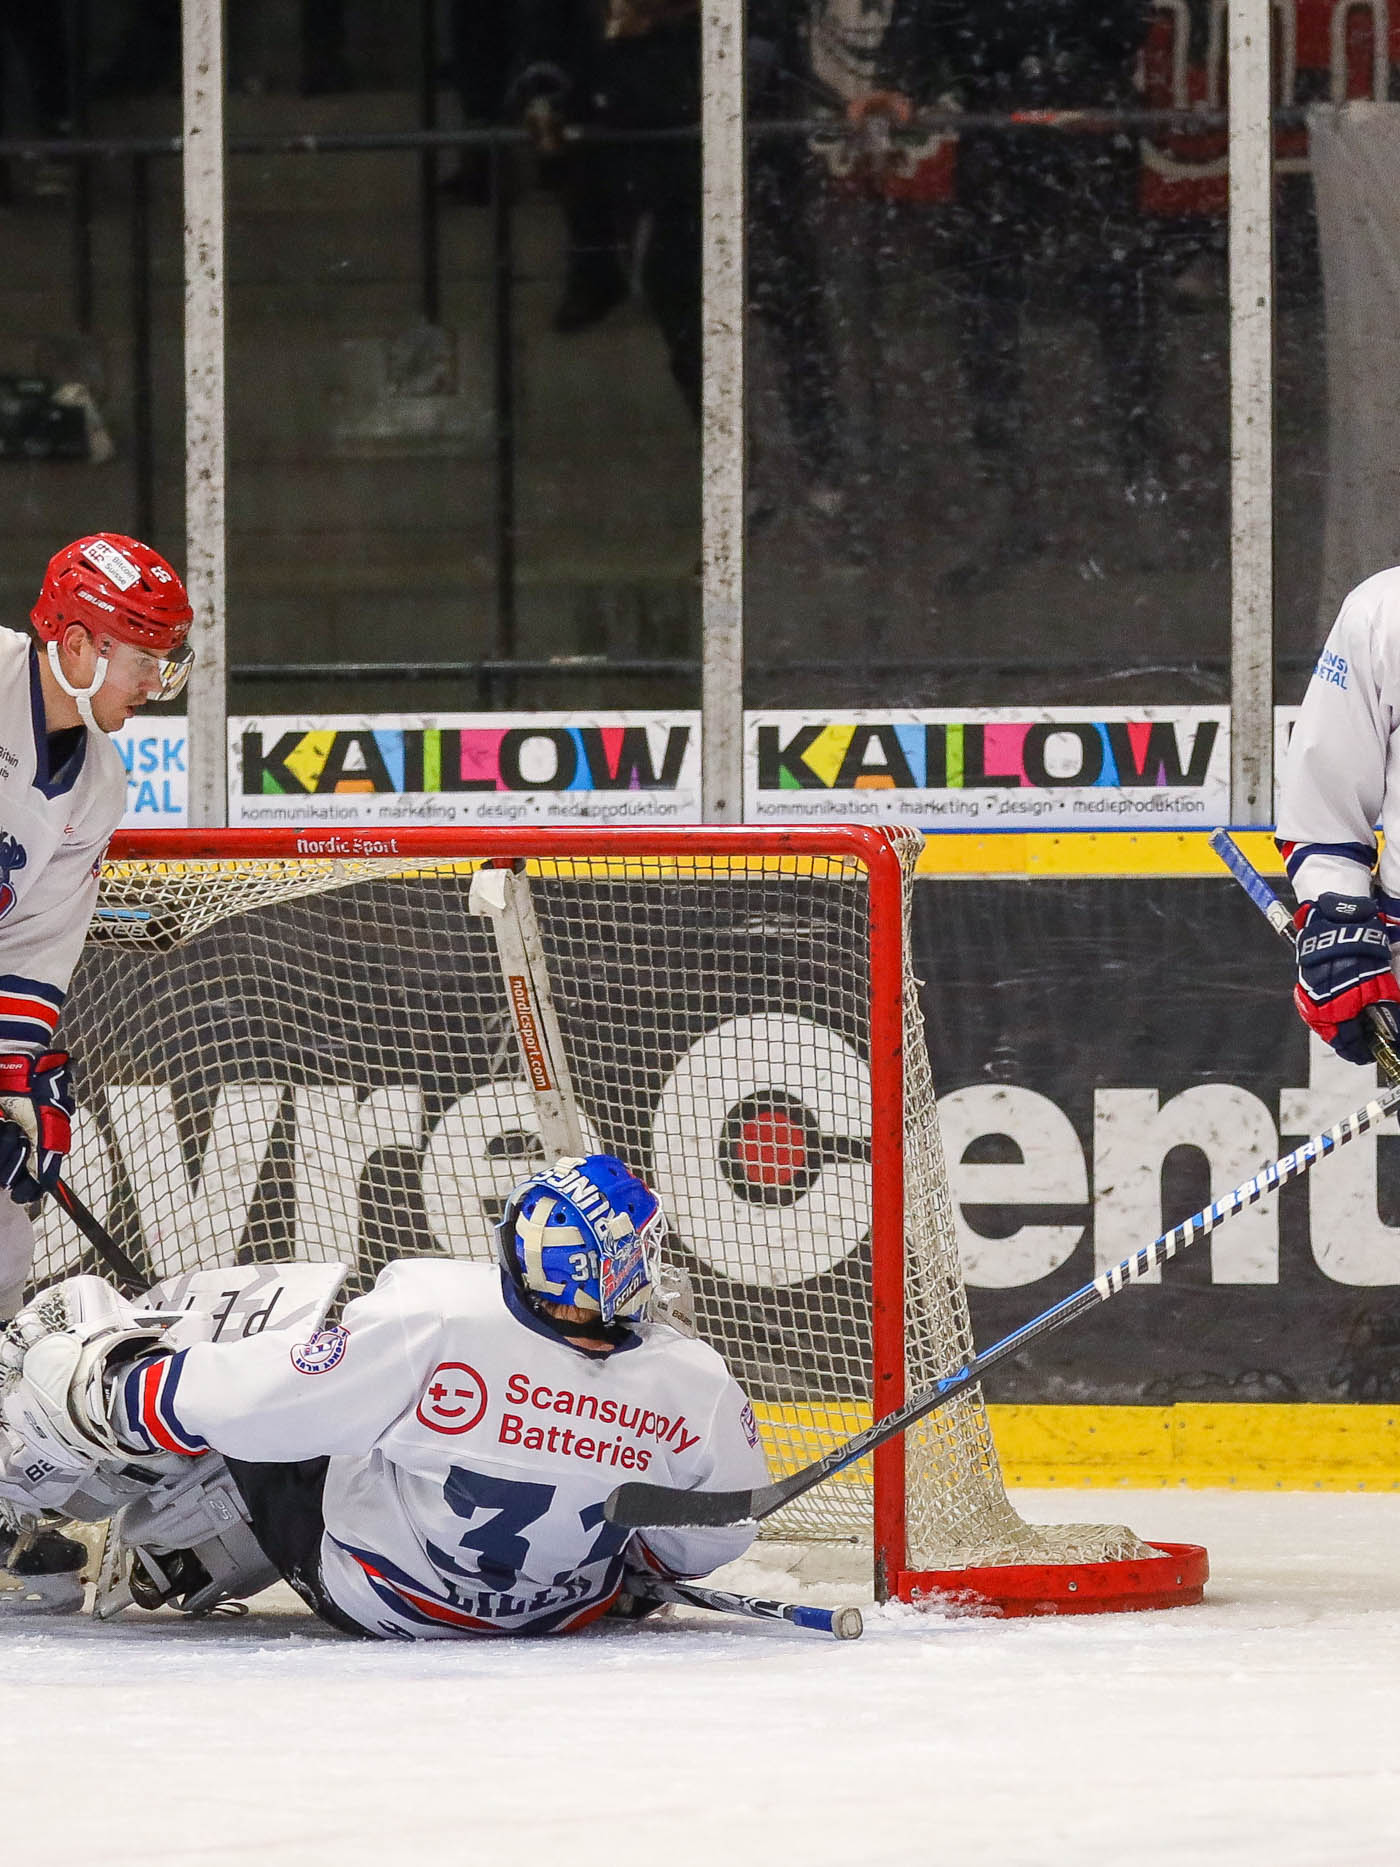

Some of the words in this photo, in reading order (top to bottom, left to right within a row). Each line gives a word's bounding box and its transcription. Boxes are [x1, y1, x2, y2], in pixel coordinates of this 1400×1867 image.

[112, 738, 186, 773] NSK
[242, 726, 691, 795] KAILOW
[758, 721, 1220, 790] KAILOW
[241, 804, 359, 821] kommunikation
[379, 804, 457, 820] marketing
[477, 803, 527, 820] design
[756, 800, 879, 817] kommunikation
[899, 800, 979, 818] marketing
[998, 799, 1053, 816] design
[1073, 799, 1206, 815] medieproduktion
[512, 978, 548, 1090] nordicsport.com
[497, 1413, 652, 1472] Batteries
[505, 1373, 701, 1455] Scansupply
